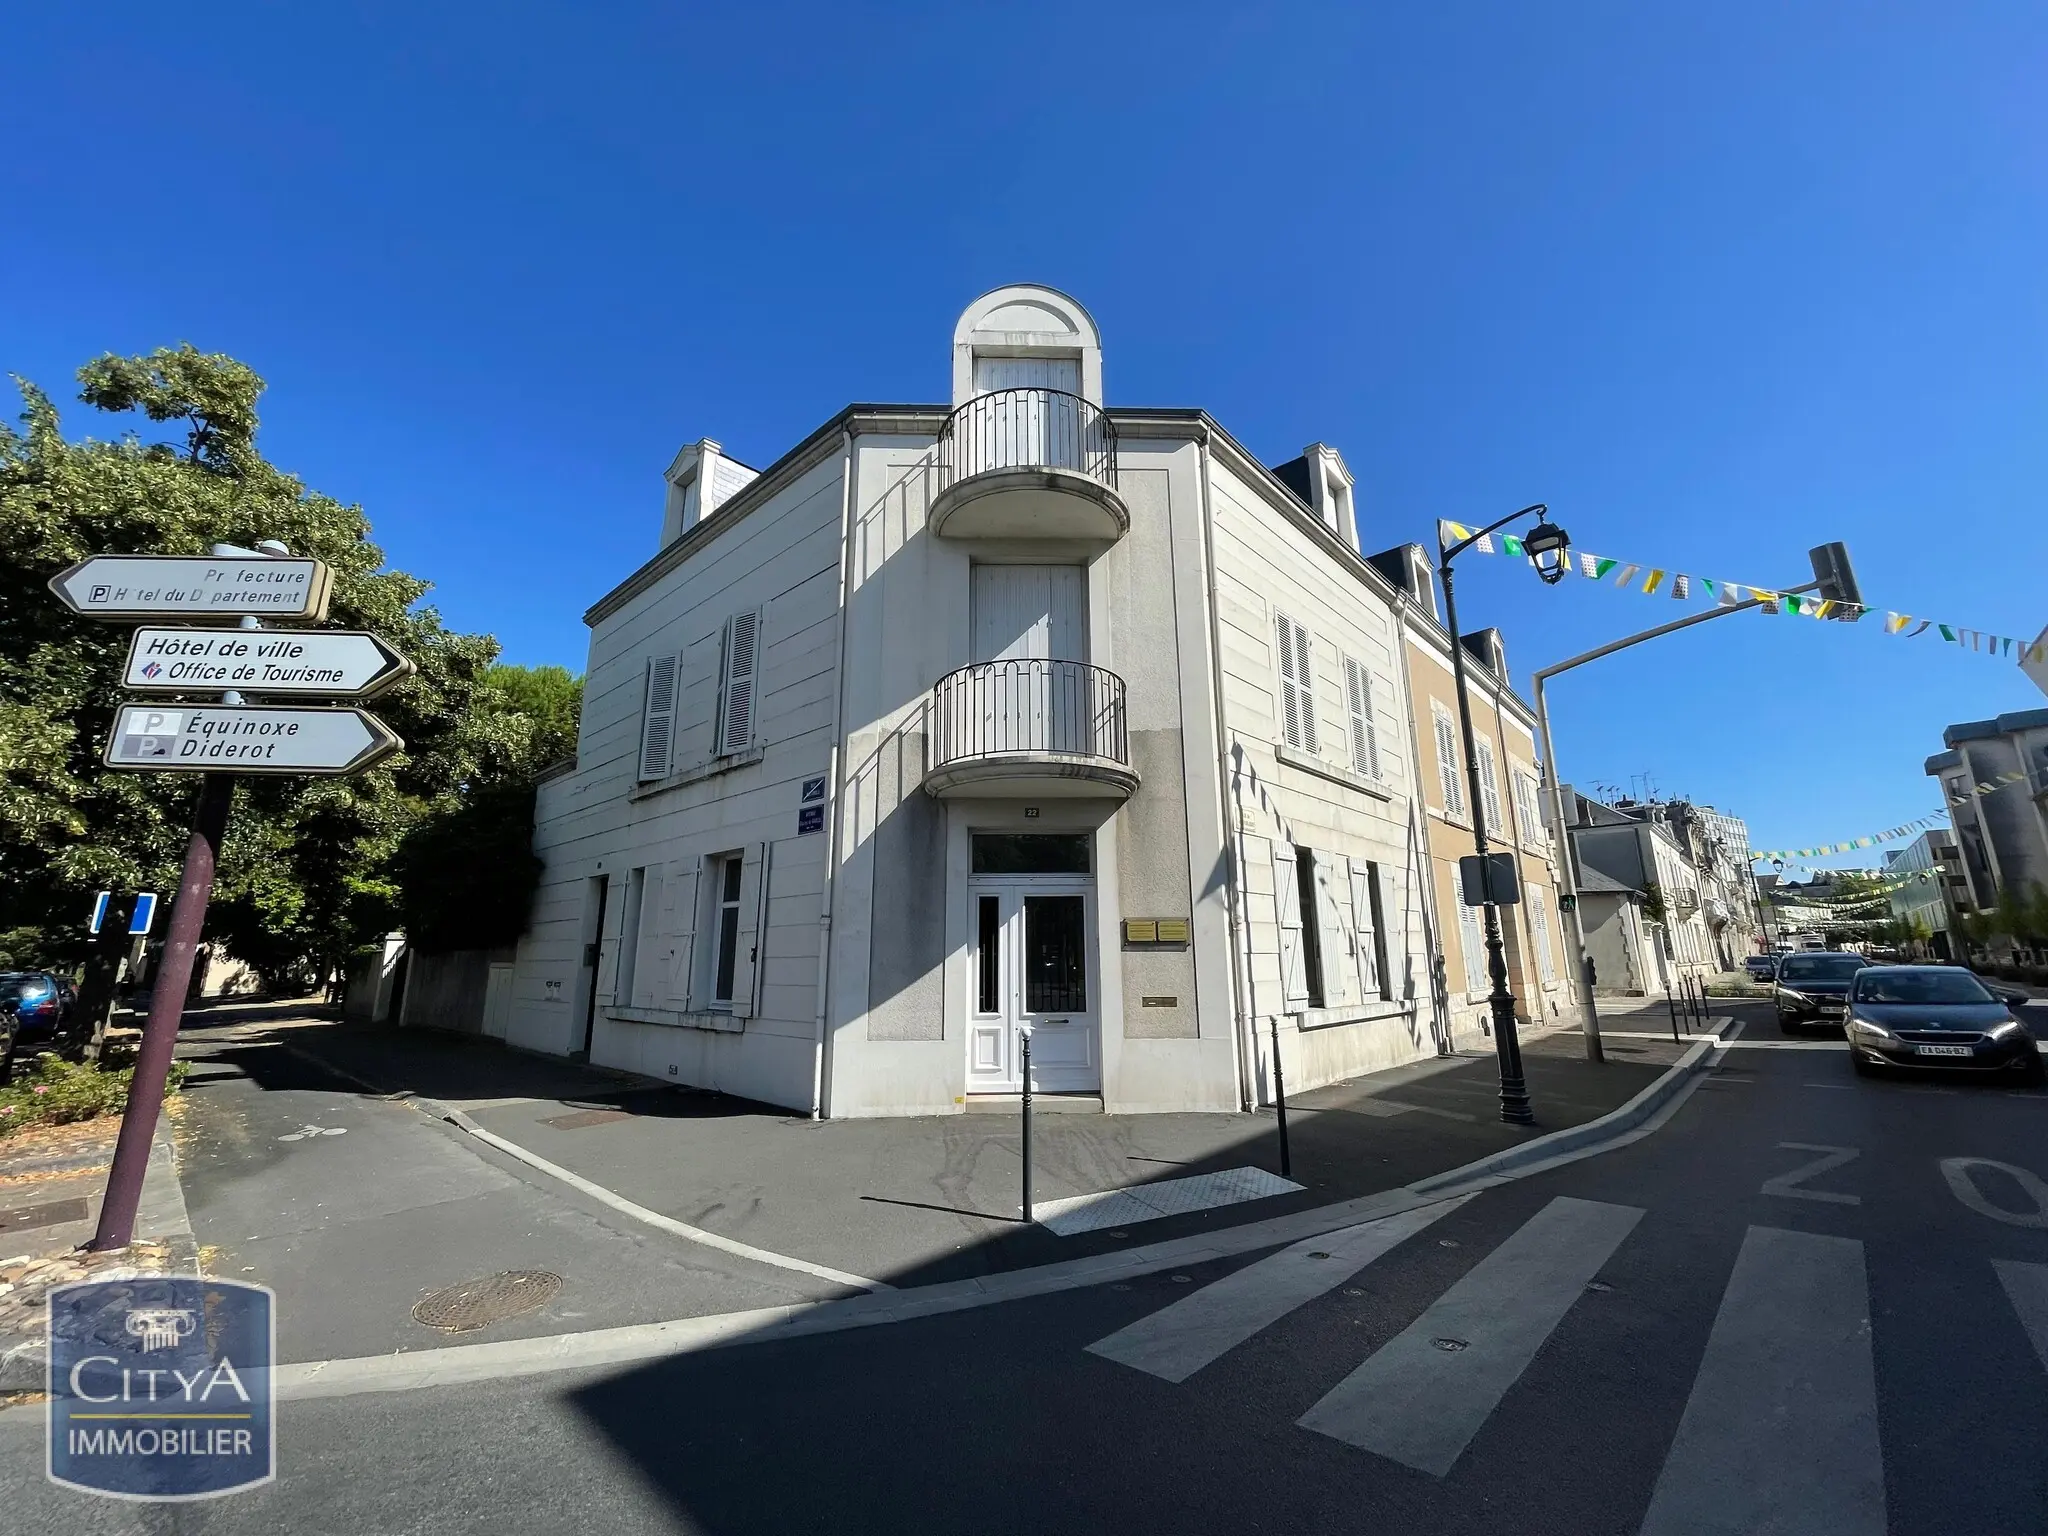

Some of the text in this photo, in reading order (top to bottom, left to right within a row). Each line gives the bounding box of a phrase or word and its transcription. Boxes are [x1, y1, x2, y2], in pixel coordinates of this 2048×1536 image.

[204, 569, 305, 583] Prfecture
[114, 587, 161, 601] Htel
[164, 588, 186, 602] du
[190, 588, 300, 604] Dpartement
[146, 638, 304, 658] Hôtel de ville
[168, 661, 344, 682] Office de Tourisme
[143, 711, 299, 738] P Équinoxe
[137, 735, 276, 759] P Diderot
